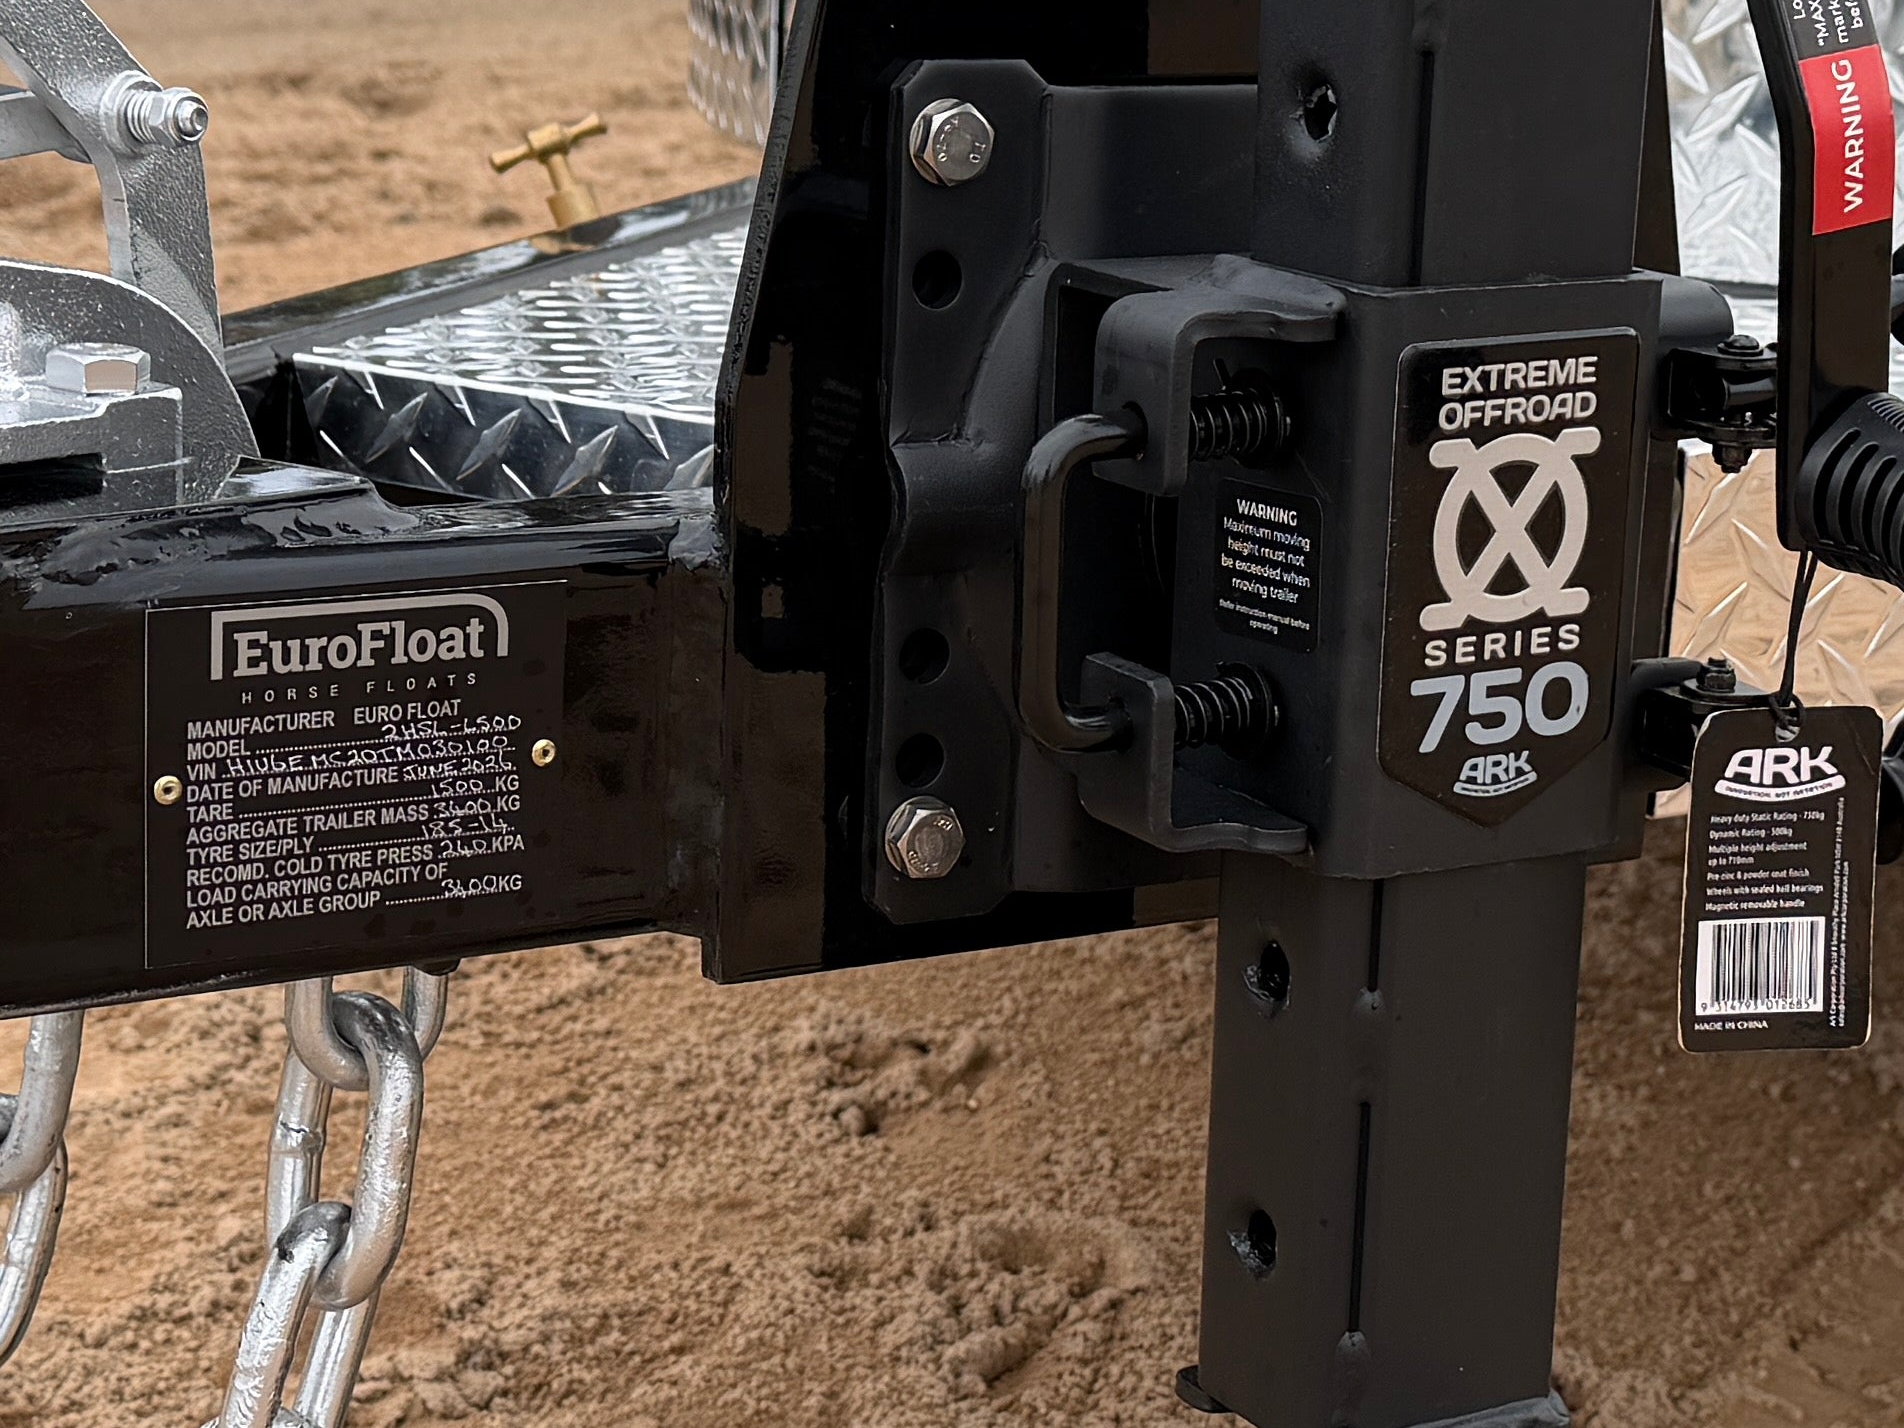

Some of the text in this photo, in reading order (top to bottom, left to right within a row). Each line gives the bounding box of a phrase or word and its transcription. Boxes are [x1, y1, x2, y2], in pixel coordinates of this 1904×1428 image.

[1831, 59, 1864, 213] WARNING
[1442, 356, 1598, 397] EXTREME
[1439, 391, 1597, 432] OFFROAD
[1237, 499, 1297, 526] WARNING
[1224, 516, 1310, 552] Maximum moving
[1228, 536, 1304, 567] height must not
[1221, 552, 1310, 588] be exceeded when
[1232, 577, 1298, 603] moving trailer
[233, 617, 485, 678] EuroFloat
[1424, 625, 1581, 667] SERIES
[242, 673, 477, 704] HORSE FLOATS
[187, 699, 461, 739] MANUFACTURER EURO FLOAT
[1410, 661, 1589, 754] 750
[187, 740, 250, 760] MODEL
[1459, 750, 1532, 784] ARK
[1724, 746, 1838, 785] ARK
[187, 763, 215, 781] VIN
[187, 750, 512, 802] DATE OF MANUFACTURE JUNE 2026
[187, 775, 519, 823] TARE 1500 KG
[187, 815, 297, 845] AGGREGATE
[304, 809, 375, 832] TRAILER
[382, 804, 429, 825] MASS
[498, 795, 520, 812] KG
[1709, 829, 1740, 840] Dynamic
[1742, 827, 1766, 838] Rating
[1710, 816, 1732, 824] Heavy
[1734, 814, 1750, 823] duty
[1751, 812, 1772, 822] Static
[1774, 811, 1797, 822] Rating
[187, 813, 507, 866] TYRE SIZE/PLY 185-14
[1709, 842, 1807, 854] Multiple height adjustment
[187, 835, 524, 887] RECOMD. COLD TYRE PRESS 240 KPA
[1708, 859, 1717, 867] up
[1719, 857, 1726, 865] to
[1744, 870, 1770, 880] powder
[187, 861, 448, 908] LOAD CARRYING CAPACITY OF
[187, 907, 233, 929] AXLE
[238, 904, 265, 923] OR
[268, 896, 314, 919] AXLE
[319, 890, 381, 913] GROUP
[499, 875, 522, 892] KG
[1707, 887, 1732, 896] Wheels
[1734, 885, 1750, 894] with
[1792, 884, 1823, 894] bearings
[1706, 899, 1805, 912] Magnetic removable handle
[1695, 1020, 1769, 1031] MADE IN CHINA
[1701, 1003, 1708, 1012] 9
